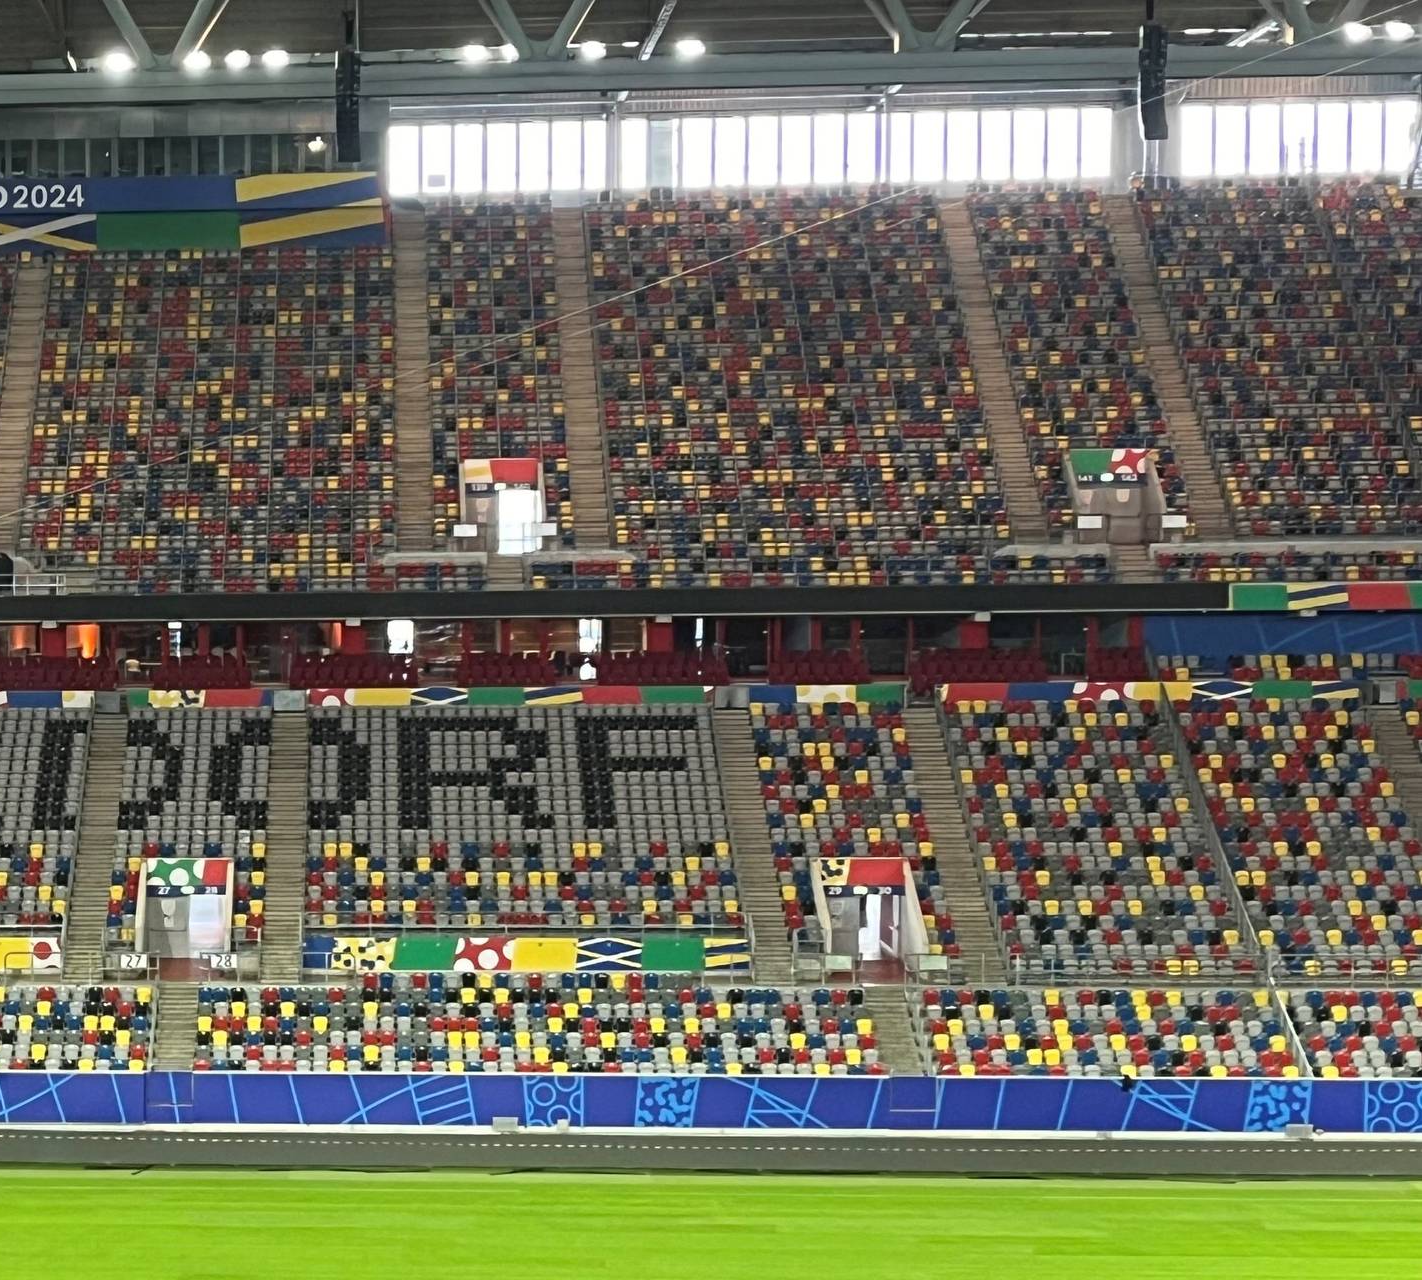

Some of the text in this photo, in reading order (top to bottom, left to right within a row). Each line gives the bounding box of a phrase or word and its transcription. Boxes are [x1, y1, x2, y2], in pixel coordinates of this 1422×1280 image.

[157, 886, 171, 895] 27
[125, 954, 141, 968] 27
[217, 954, 232, 968] 28
